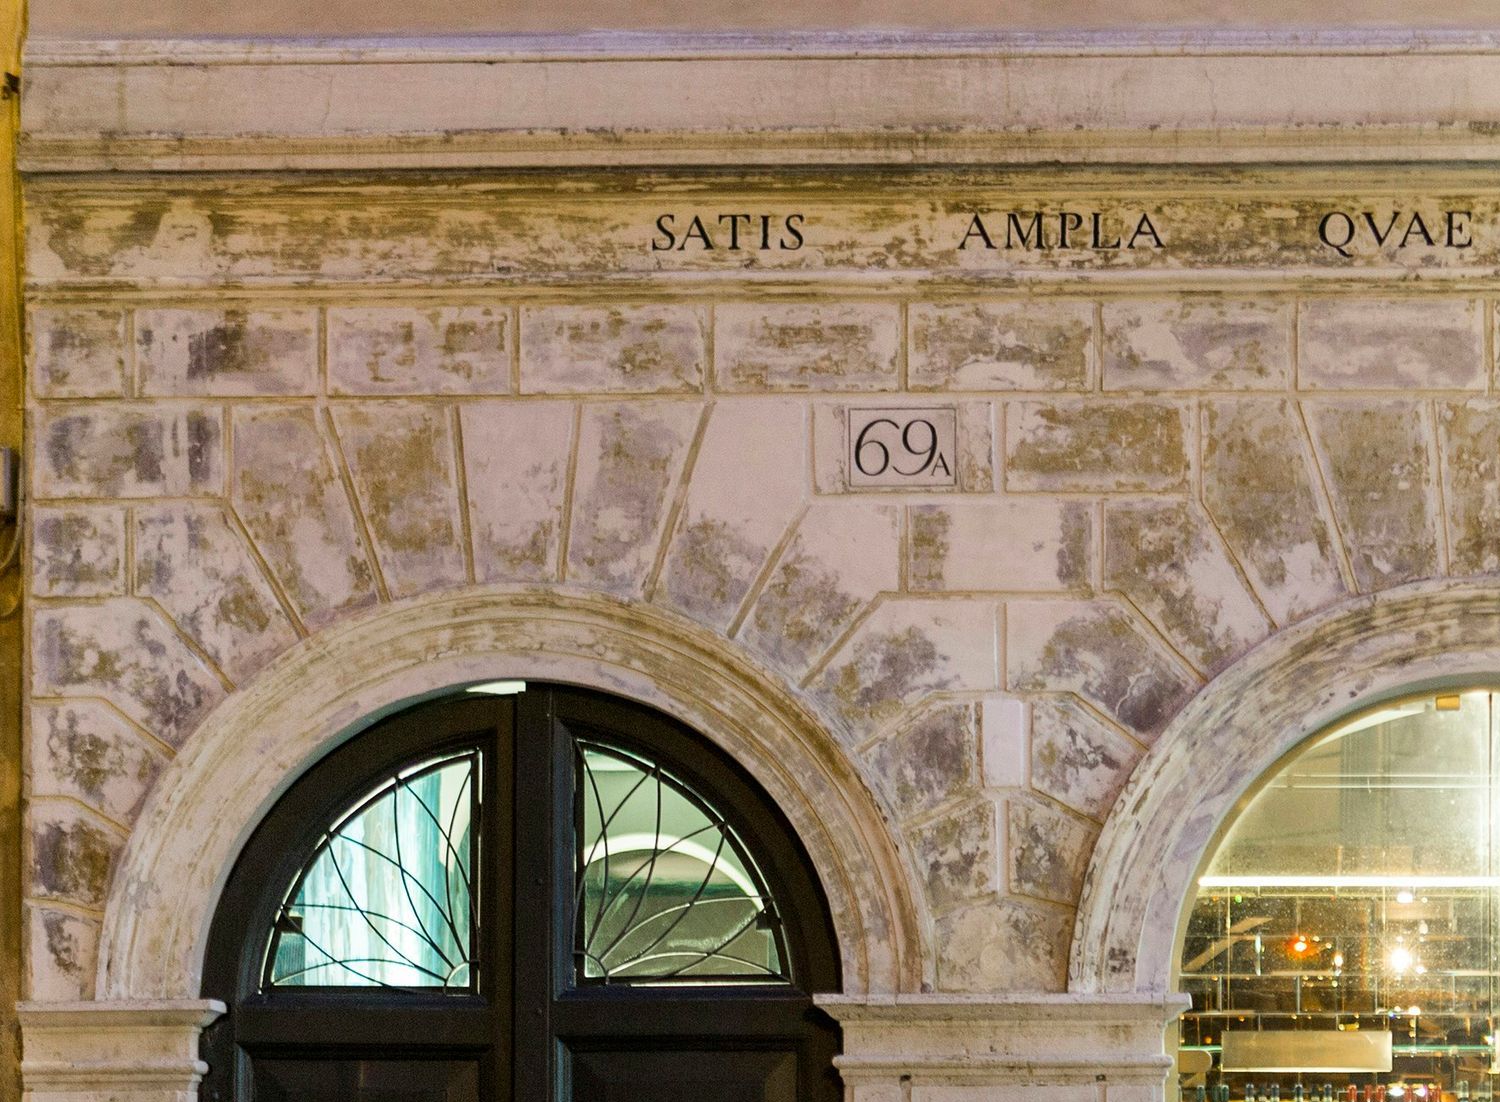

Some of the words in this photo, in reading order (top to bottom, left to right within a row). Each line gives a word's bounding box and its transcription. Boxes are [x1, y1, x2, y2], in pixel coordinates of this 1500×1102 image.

[650, 211, 806, 252] SATIS
[957, 211, 1166, 251] AMPLA
[1317, 209, 1474, 258] QVAE
